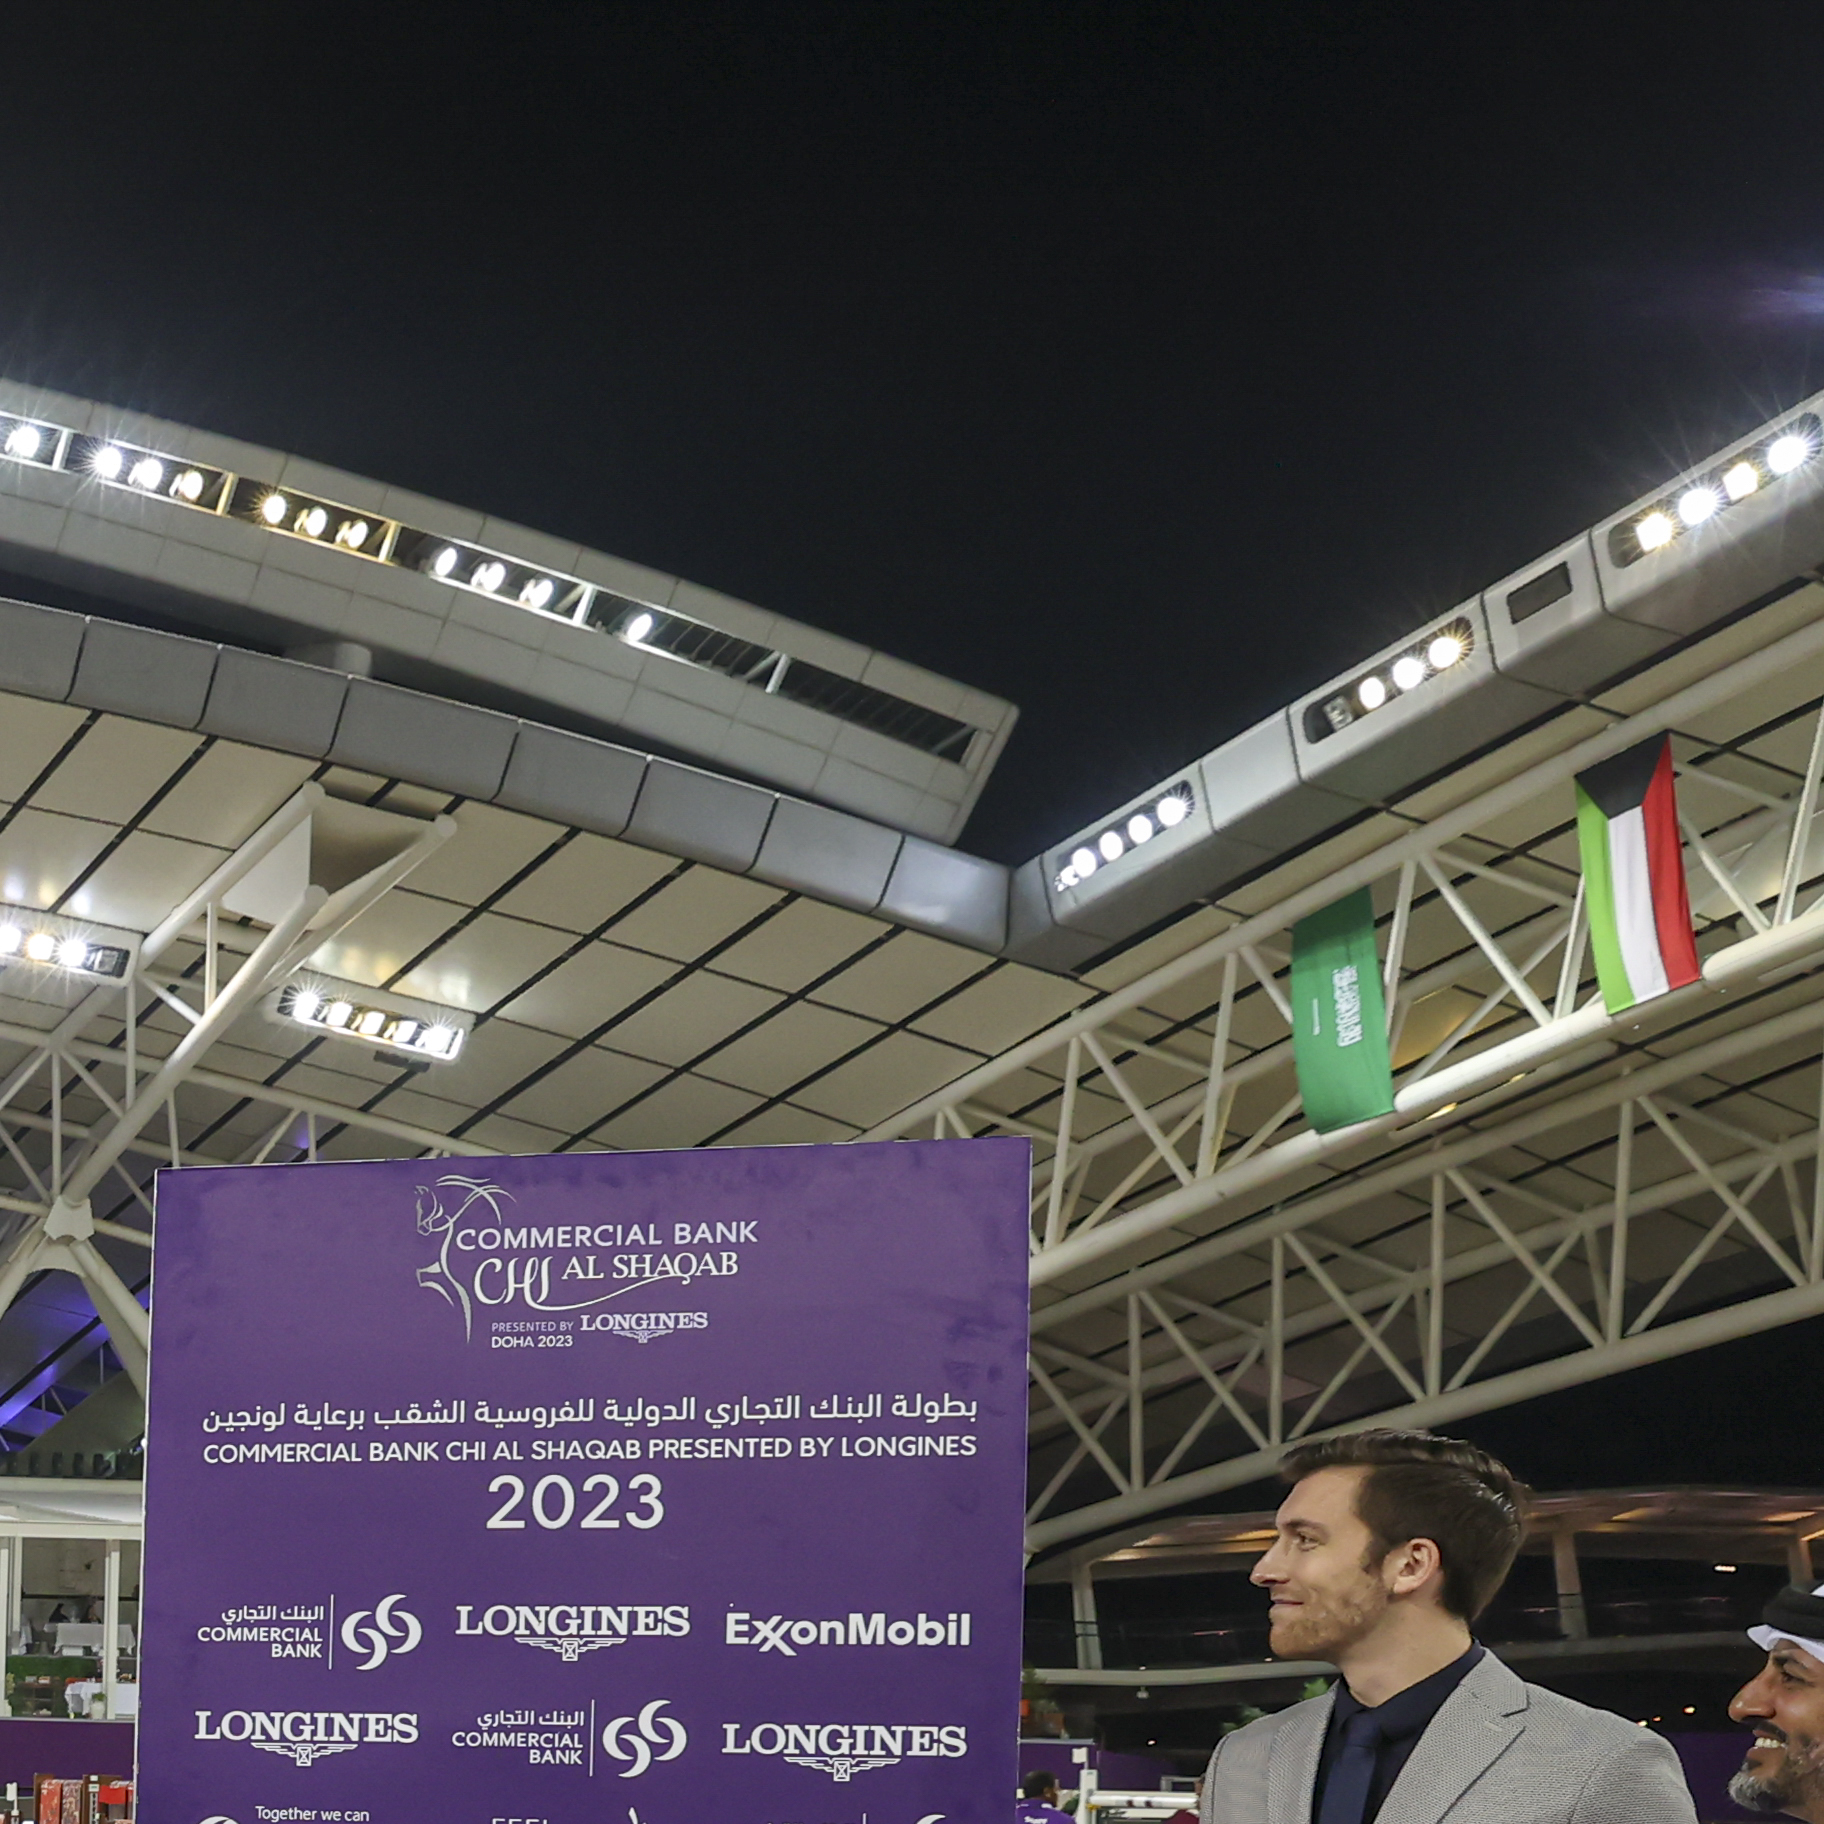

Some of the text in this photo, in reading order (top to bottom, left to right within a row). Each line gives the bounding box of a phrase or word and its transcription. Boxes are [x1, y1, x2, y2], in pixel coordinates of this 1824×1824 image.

[456, 1221, 758, 1250] COMMERCIAL BANK
[473, 1251, 739, 1309] CHI AL SHAQAB
[492, 1312, 708, 1332] PRESENTED BY LONGINES
[492, 1335, 573, 1348] DOHA 2023
[203, 1393, 977, 1432] بطولة البنك التجاري الدولية للفروسية الشقب برعاية لونجين
[204, 1435, 976, 1463] COMMERCIAL BANK CHI AL SHAQAB PRESENTED BY LONGINES
[486, 1474, 664, 1529] 2023
[255, 1806, 369, 1822] Together we can
